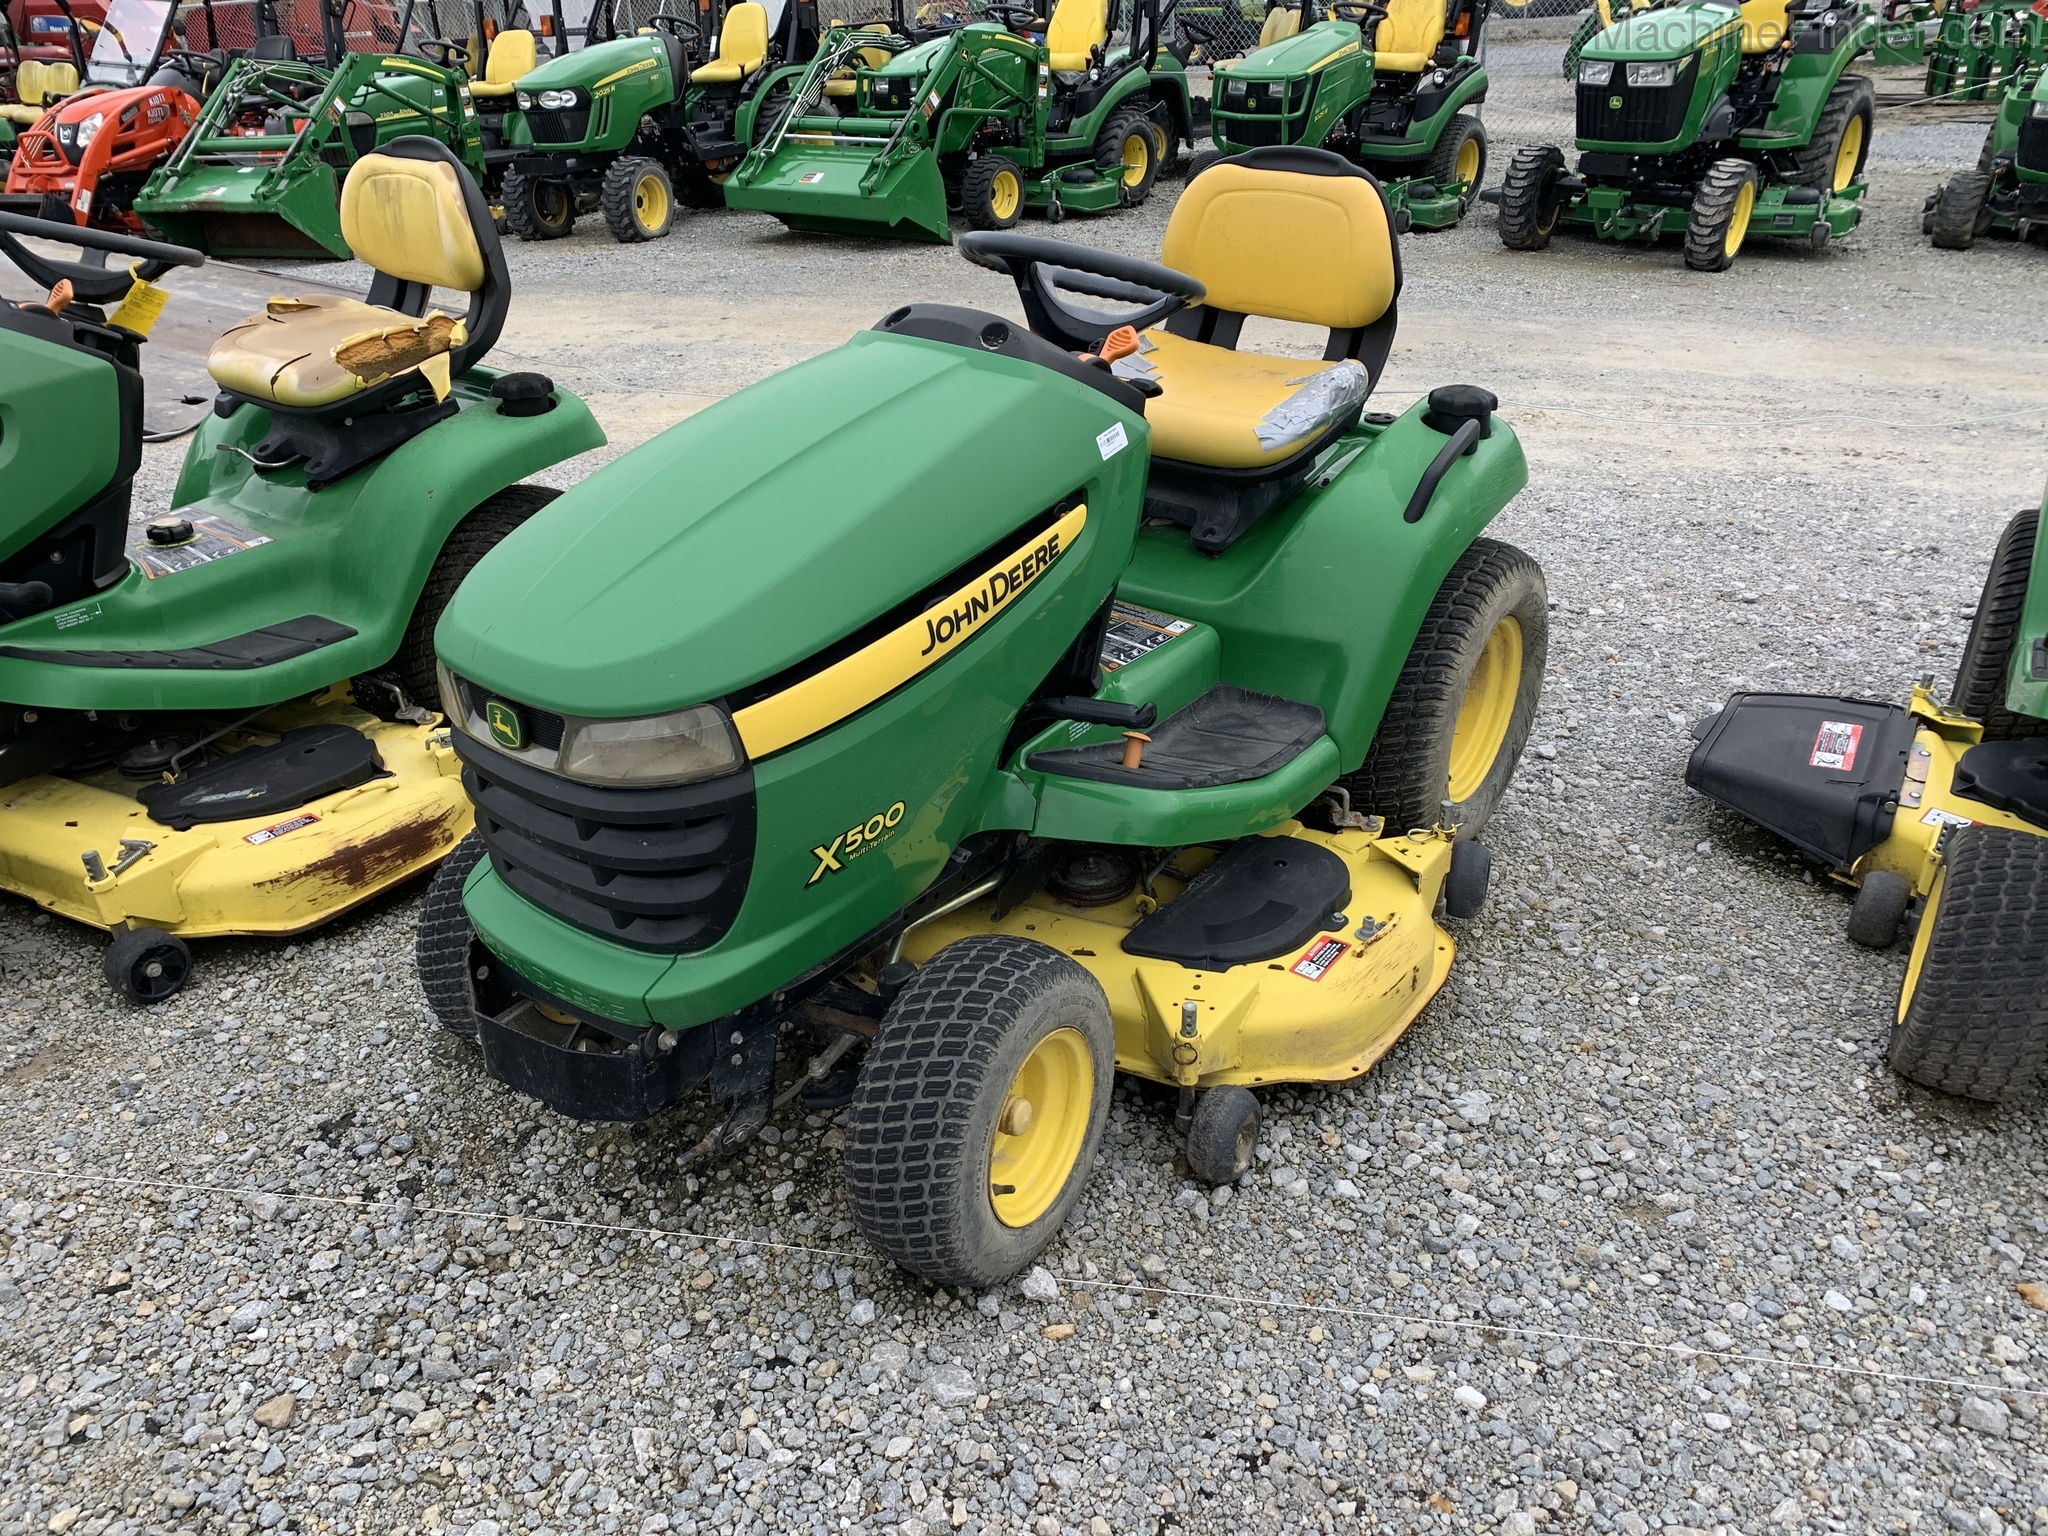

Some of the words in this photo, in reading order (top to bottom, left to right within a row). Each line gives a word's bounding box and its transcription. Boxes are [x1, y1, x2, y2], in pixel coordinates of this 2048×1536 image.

[627, 66, 640, 75] JOHN
[639, 61, 655, 70] DEERE
[148, 93, 166, 106] KIOTI
[147, 107, 164, 118] KIOTI
[921, 589, 989, 657] JOHN
[989, 533, 1061, 607] DEERE
[803, 800, 906, 889] X500
[848, 830, 895, 861] Multi-Terrain
